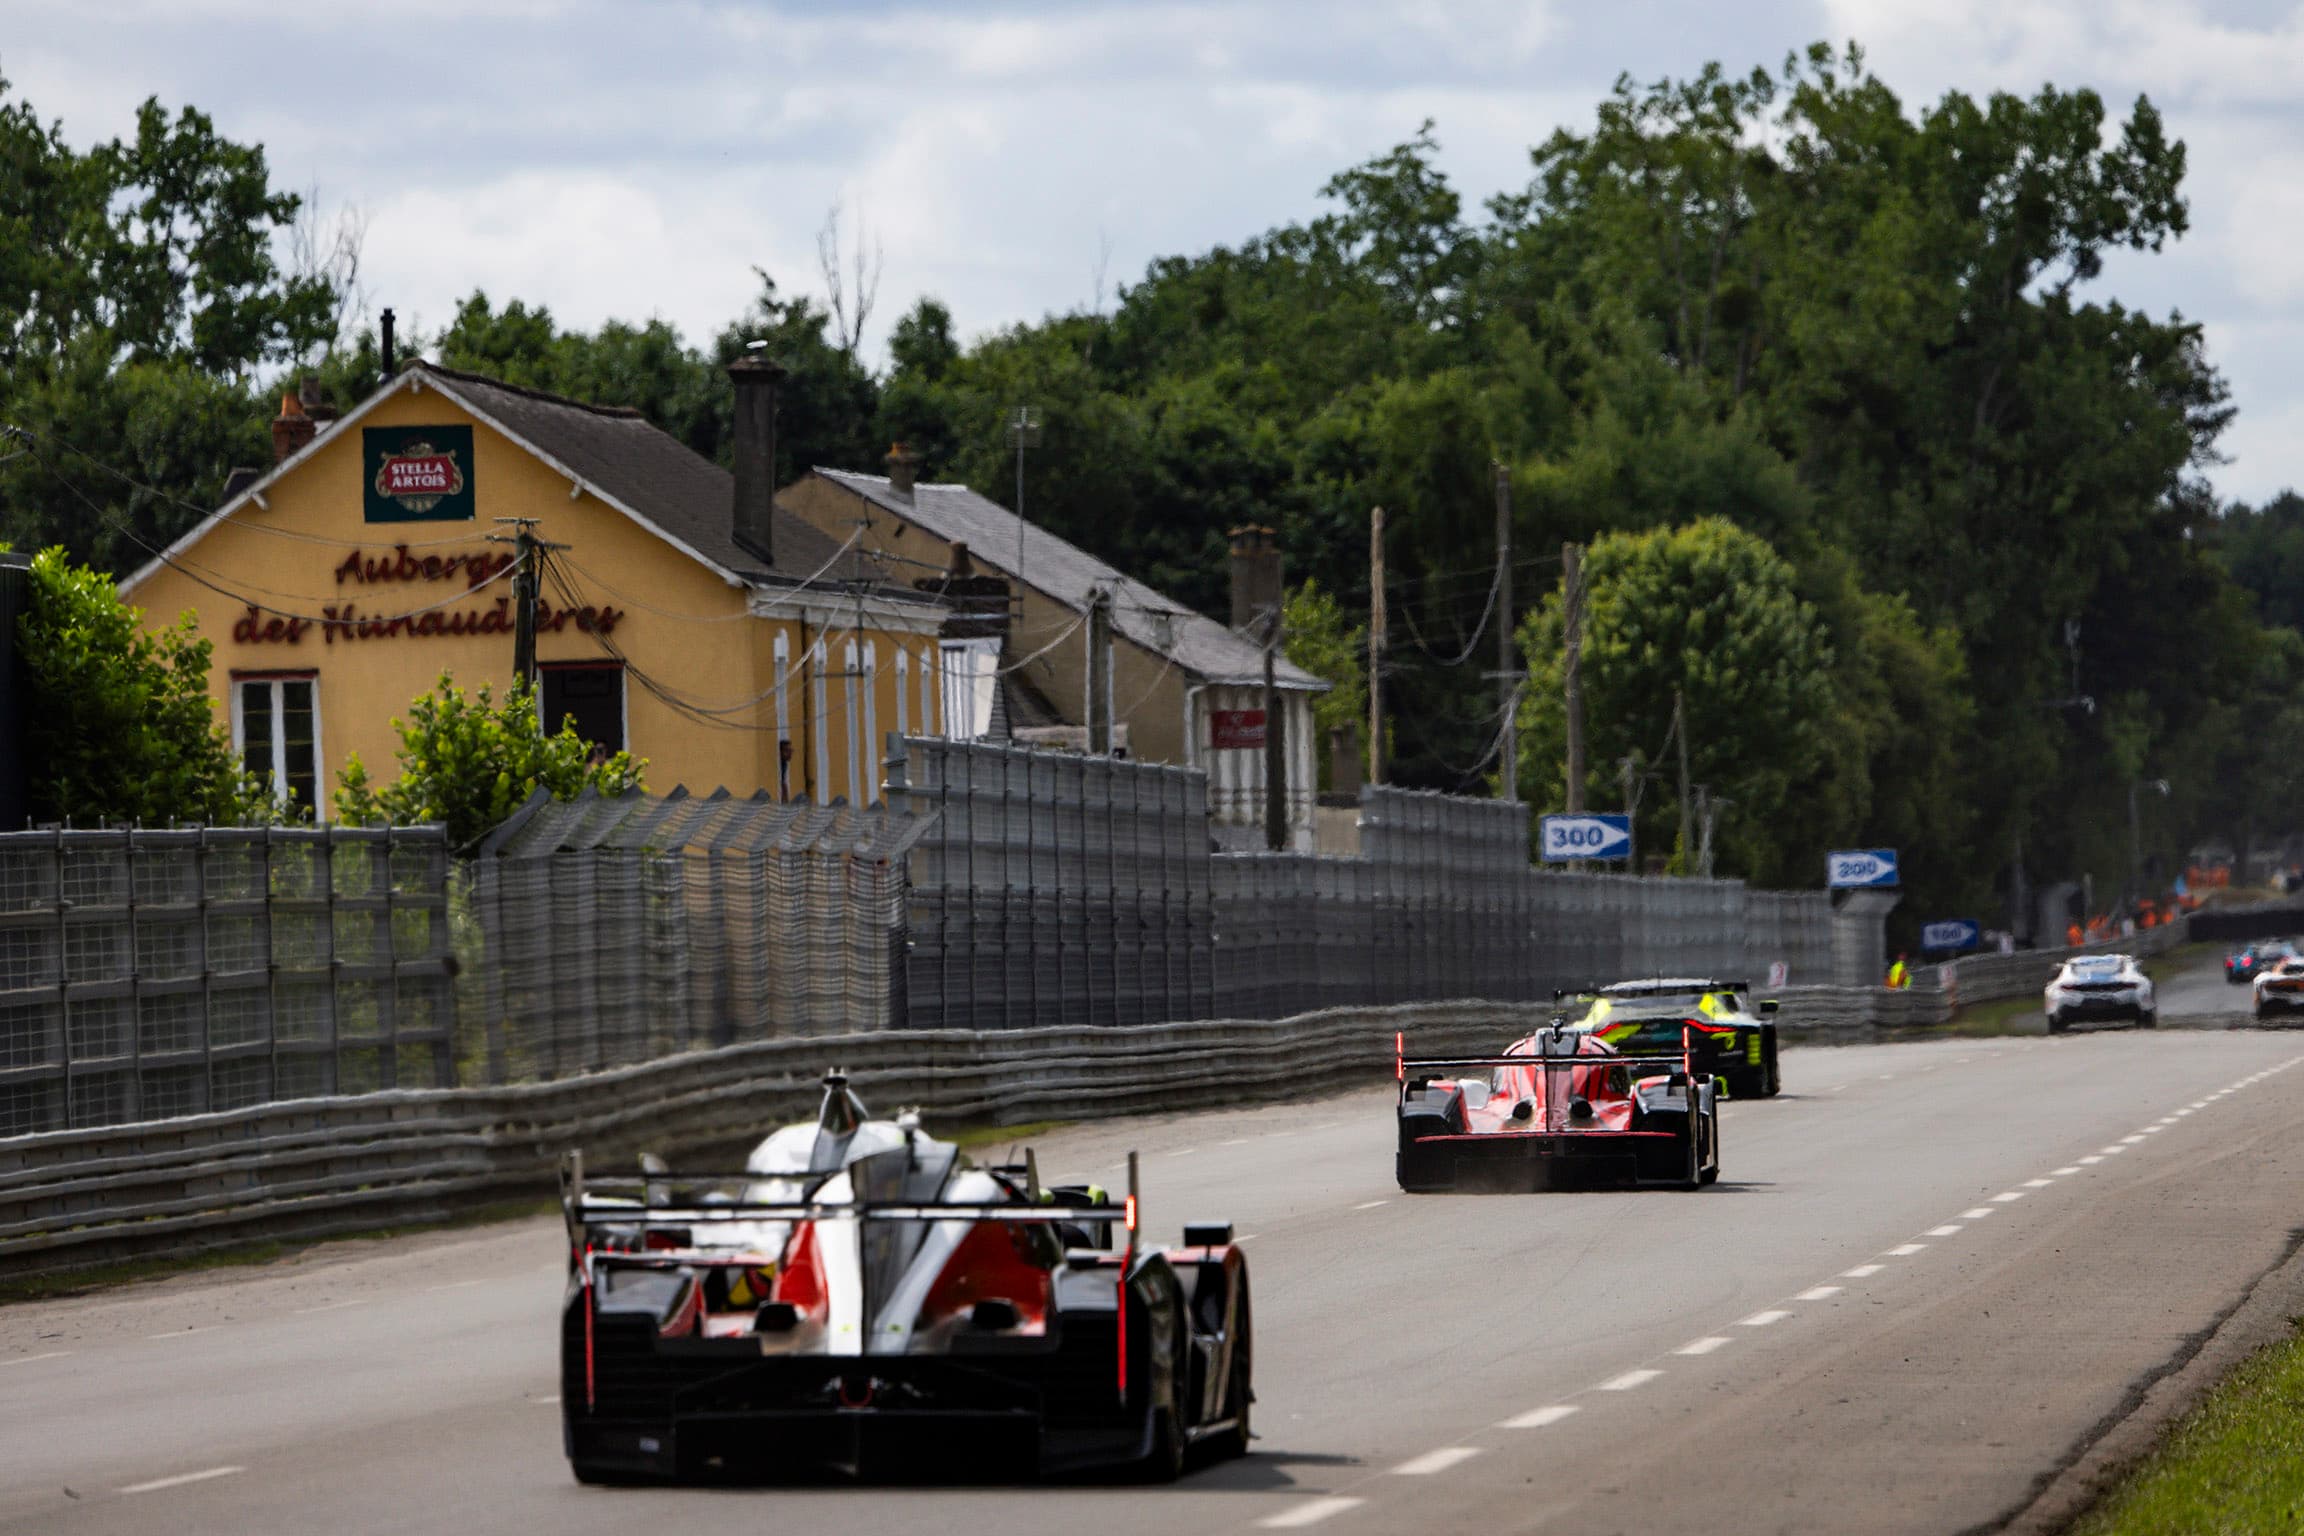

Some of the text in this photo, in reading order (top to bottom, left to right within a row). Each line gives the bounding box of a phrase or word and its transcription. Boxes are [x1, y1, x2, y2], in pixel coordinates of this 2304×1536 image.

[391, 462, 445, 475] STELLA
[392, 474, 447, 488] ARTOIS
[233, 597, 625, 645] des Hunaudères
[1551, 826, 1604, 848] 300
[1838, 861, 1877, 878] 200
